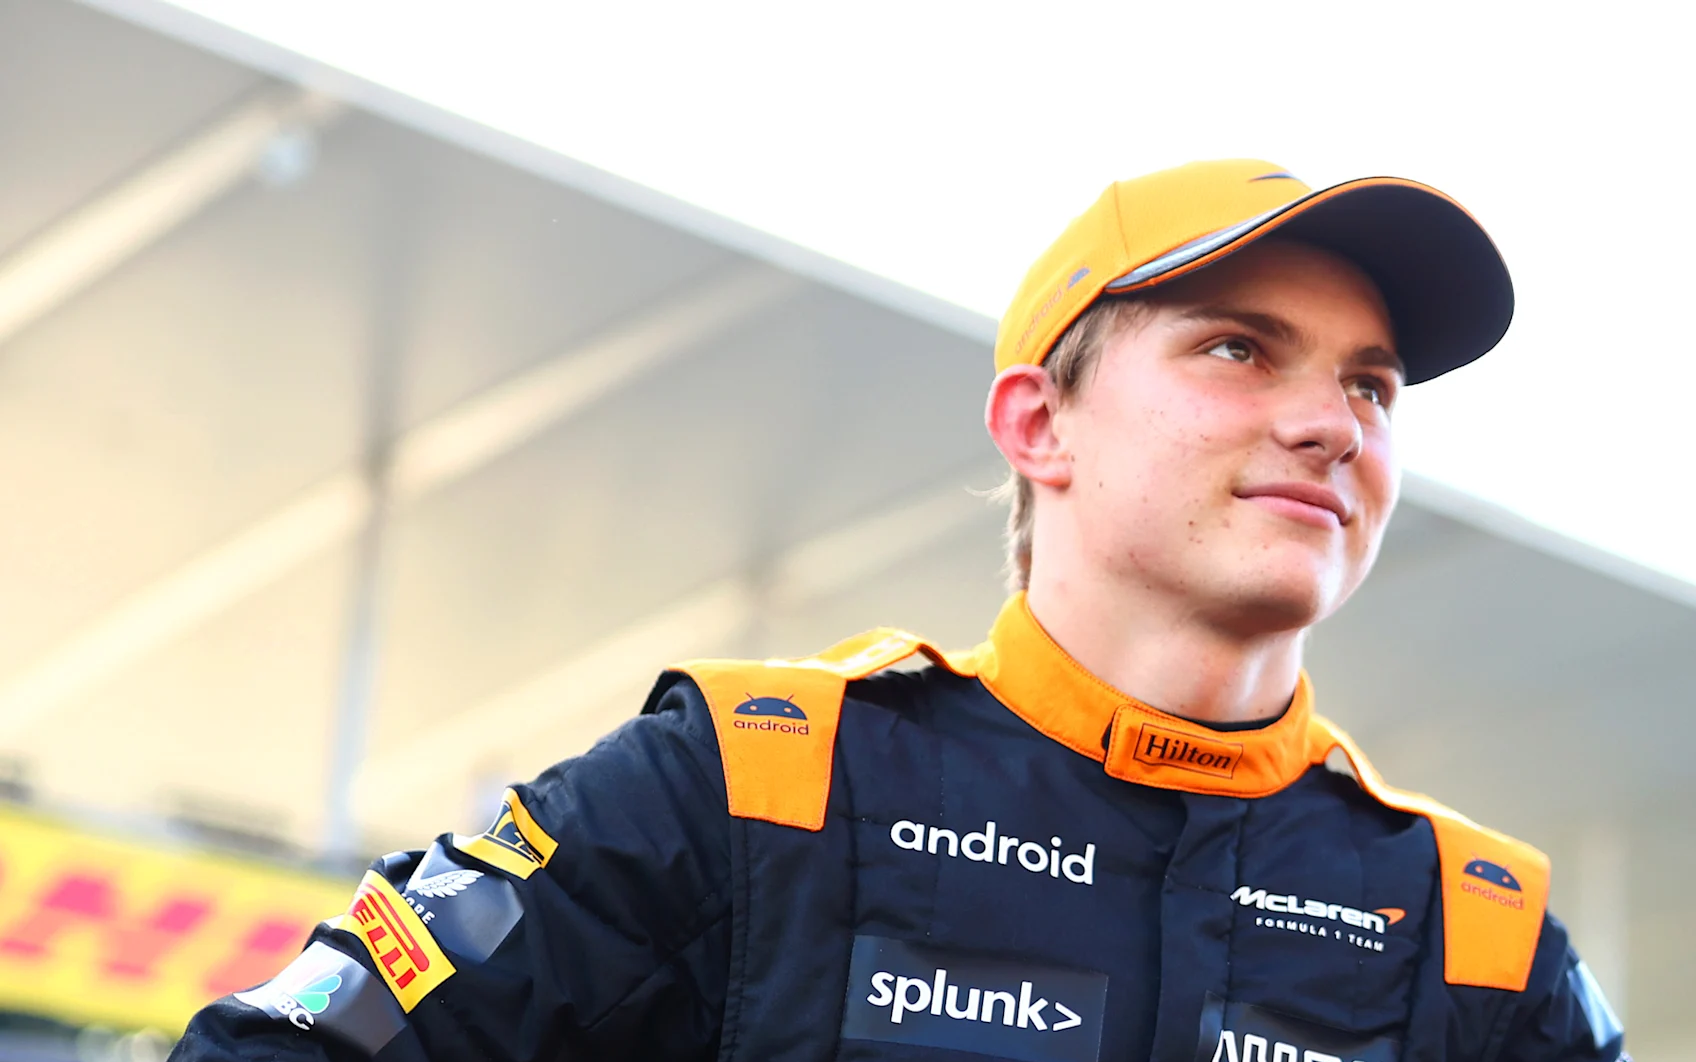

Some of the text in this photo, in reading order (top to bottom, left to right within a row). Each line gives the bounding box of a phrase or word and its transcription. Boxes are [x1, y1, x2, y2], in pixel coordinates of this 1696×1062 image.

[733, 719, 809, 735] android
[1144, 731, 1232, 770] Hilton
[890, 819, 1096, 886] android
[1230, 885, 1386, 934] McLaren
[1461, 882, 1524, 910] android
[1255, 916, 1386, 953] FORMULA 1 TEAM
